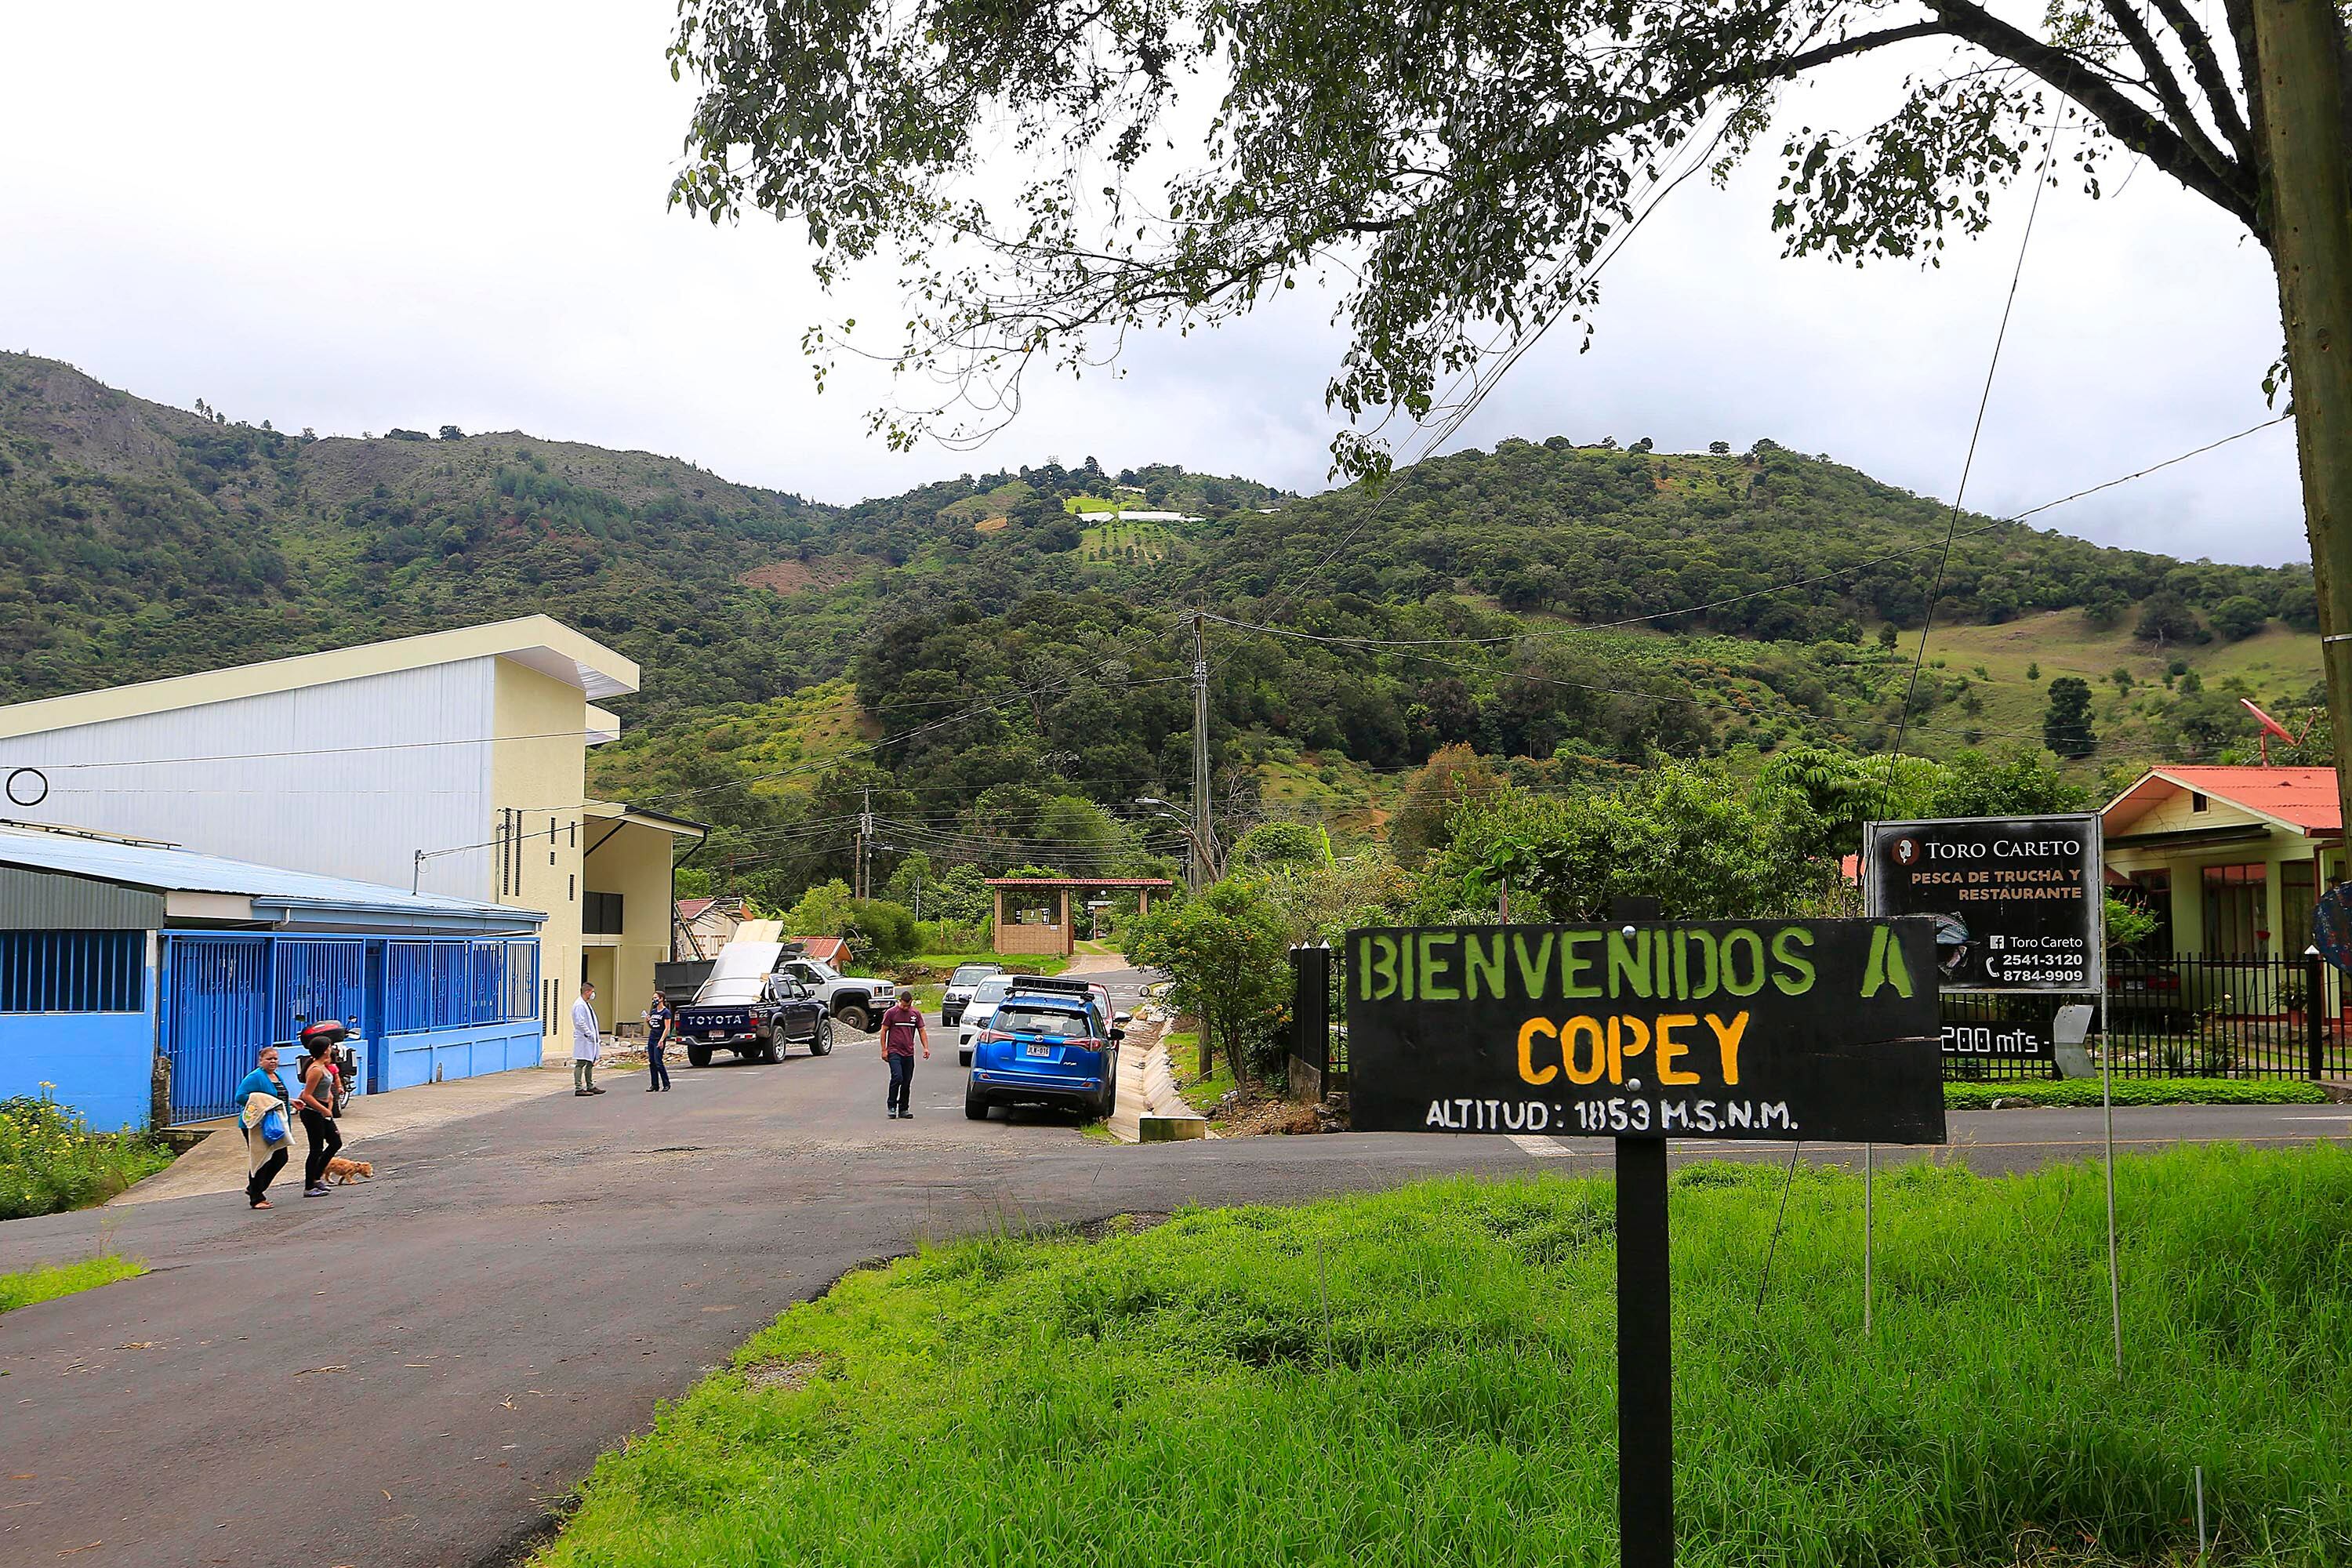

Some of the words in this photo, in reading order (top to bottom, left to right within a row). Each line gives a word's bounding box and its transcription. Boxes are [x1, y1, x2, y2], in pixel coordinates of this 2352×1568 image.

[1911, 872, 1962, 884] PESCA
[1969, 871, 1989, 883] DE
[1994, 869, 2063, 882] TRUCHA
[2069, 869, 2081, 880] Y
[1959, 887, 2082, 901] RESTAURANTE
[2010, 936, 2038, 948] Toro
[2041, 936, 2083, 948] Careto
[1359, 926, 1817, 1001] BIENVENIDOS
[1860, 925, 1914, 999] A
[2002, 954, 2083, 966] 2541-3120
[2003, 970, 2083, 982] 8784-9909
[688, 1015, 742, 1025] TOYOTA
[1940, 1026, 1991, 1052] 200
[1517, 1011, 1750, 1086] COPEY
[1573, 1098, 1650, 1131] 1853
[1660, 1098, 1798, 1132] M.S.N.M.
